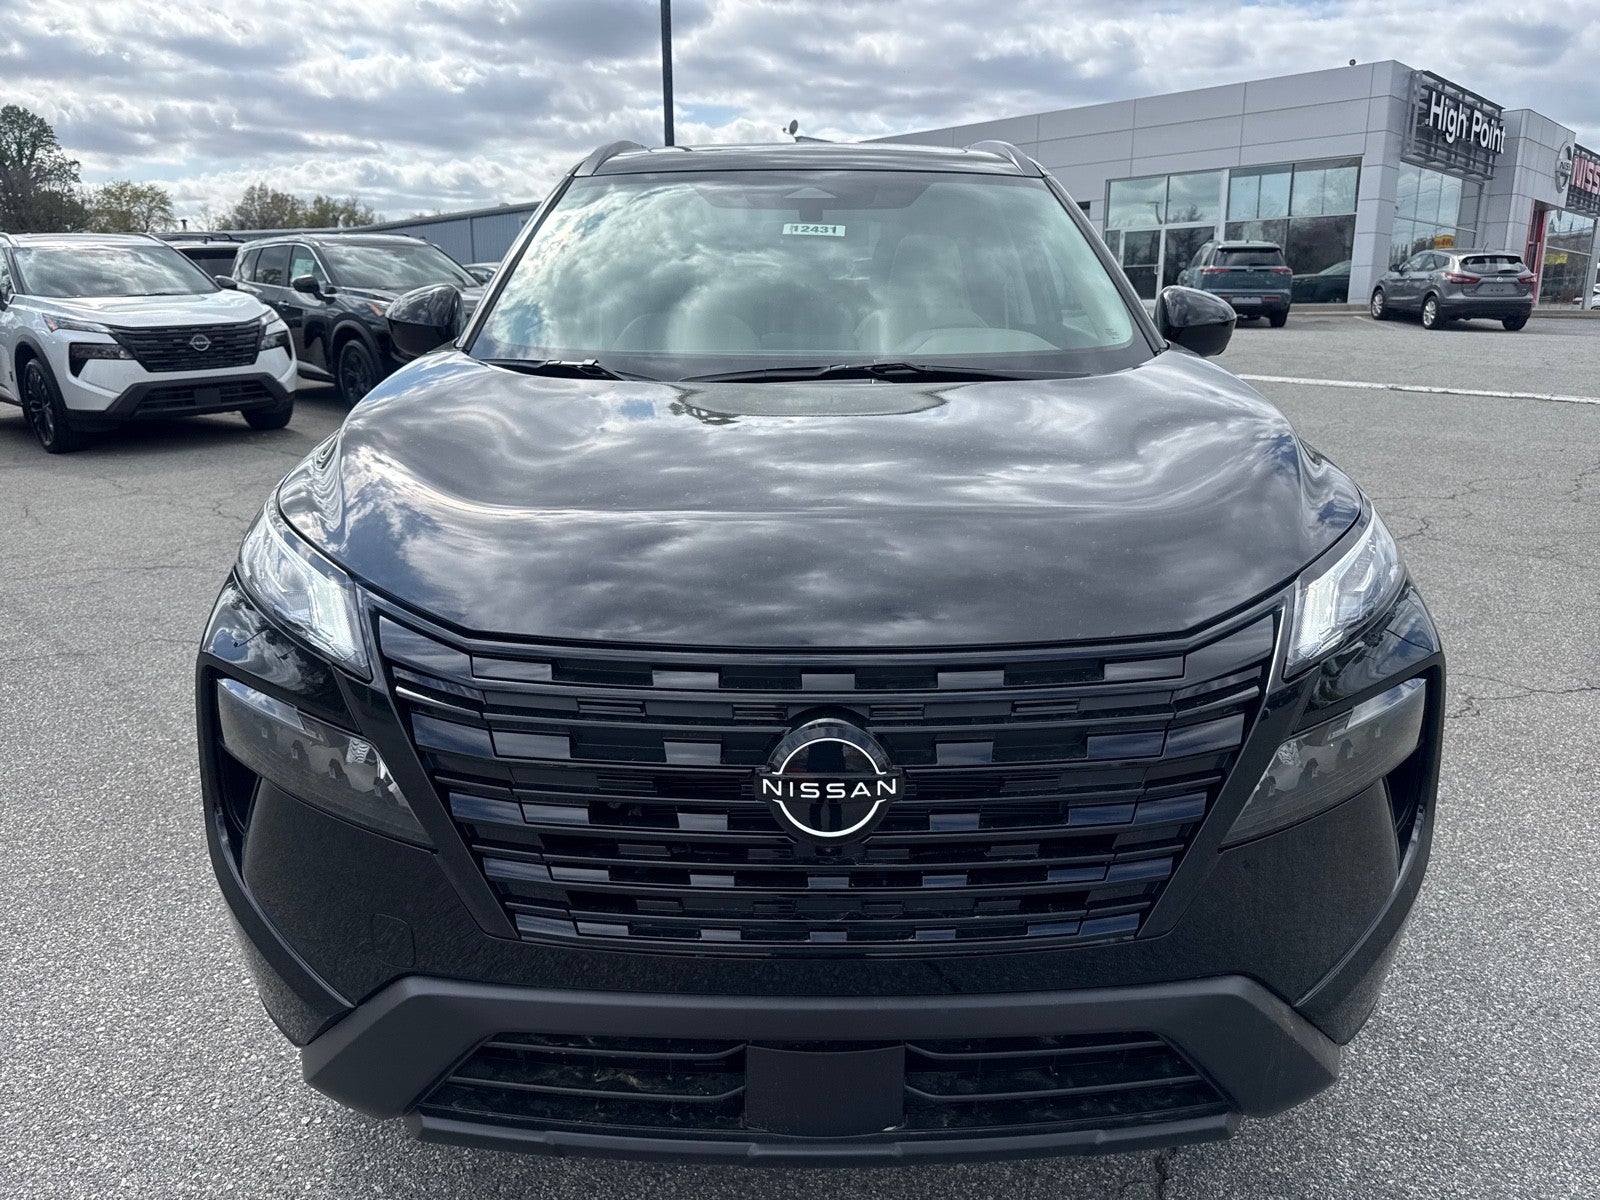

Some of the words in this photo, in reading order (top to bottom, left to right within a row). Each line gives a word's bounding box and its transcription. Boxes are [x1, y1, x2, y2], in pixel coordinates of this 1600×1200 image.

[1429, 91, 1467, 143] High
[1471, 109, 1506, 154] Point
[1571, 154, 1600, 195] NISS
[792, 225, 837, 235] 12431
[762, 778, 897, 799] NISSAN
